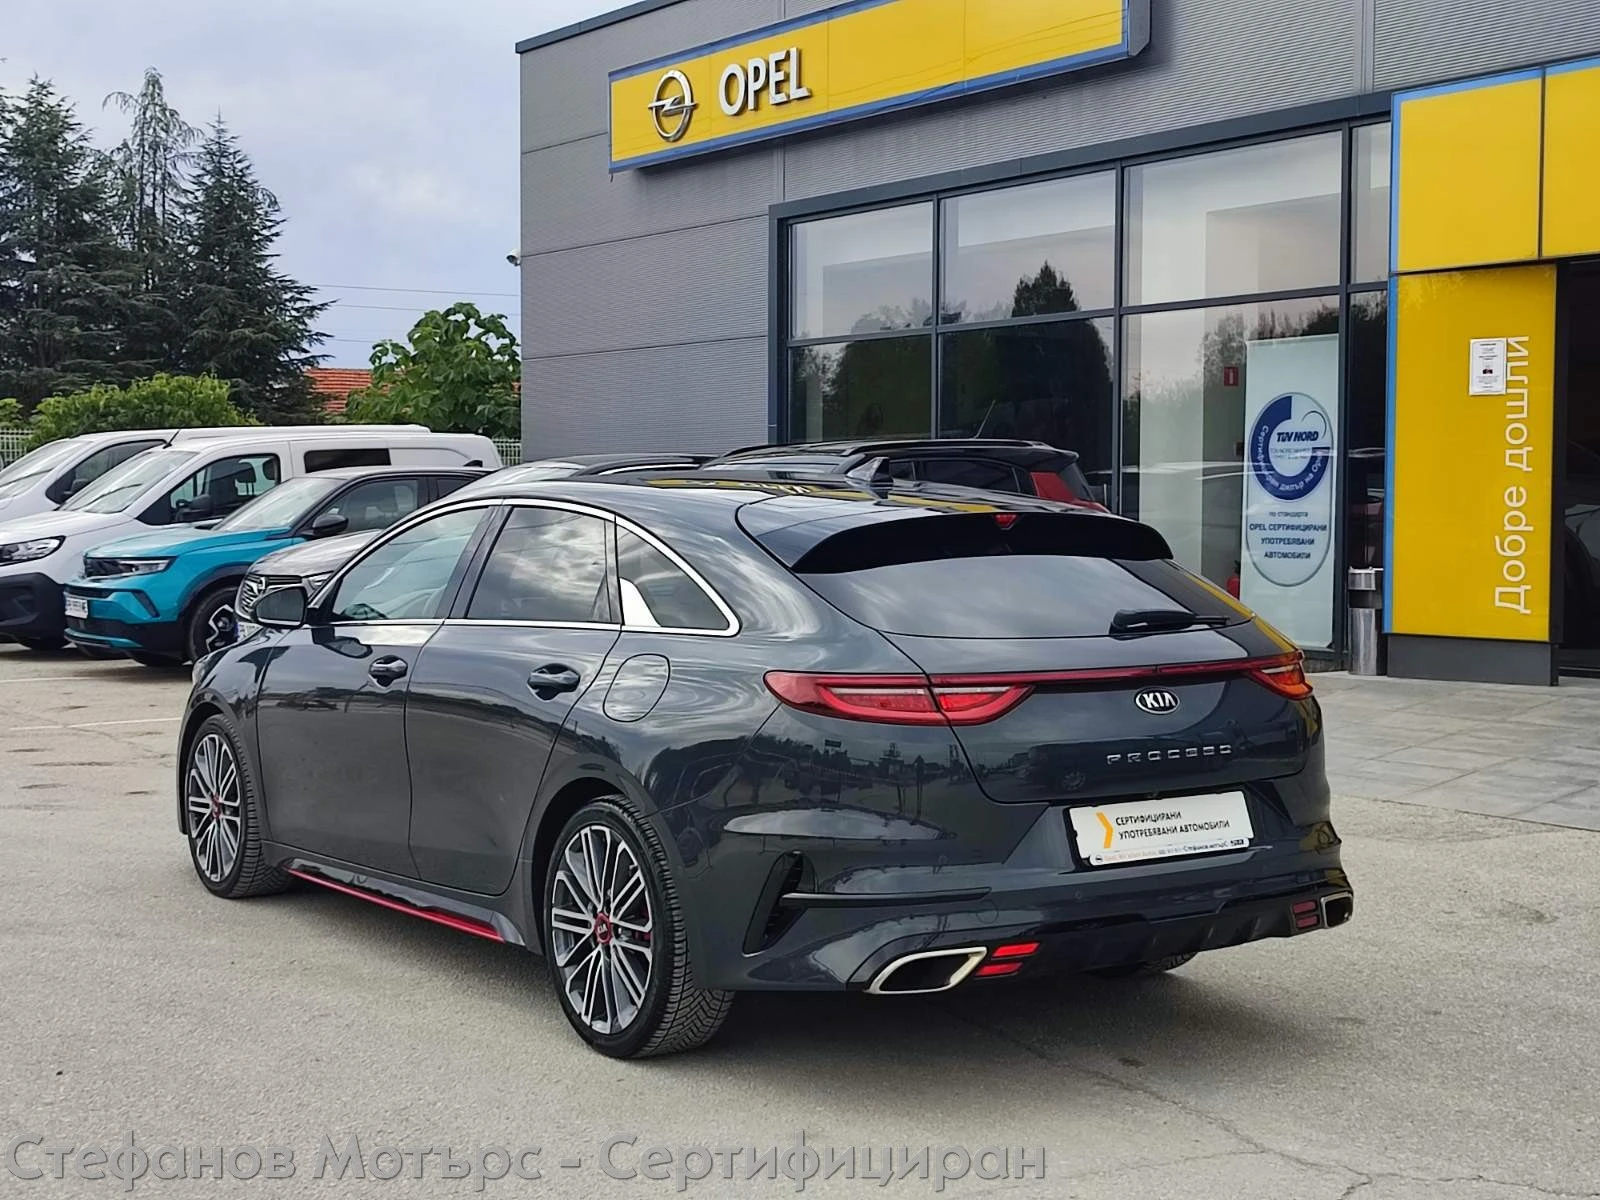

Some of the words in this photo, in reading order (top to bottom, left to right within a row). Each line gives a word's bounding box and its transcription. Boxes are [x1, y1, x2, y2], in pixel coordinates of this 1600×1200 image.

[719, 47, 810, 116] OPEL
[1505, 335, 1534, 471] дошли
[1293, 430, 1319, 442] NORD
[1249, 523, 1267, 532] OPEL
[1268, 523, 1328, 532] СЕРТИФИЦИРАНИ
[1261, 537, 1315, 546] УПОТРЕБЯВАНИ
[1494, 486, 1534, 614] Добре
[1264, 551, 1312, 560] АВТОМОБИЛИ
[1143, 691, 1177, 709] KIA
[1106, 744, 1233, 765] PROCEED
[1115, 811, 1182, 826] СЕРТИФИЦИРАНИ
[1118, 826, 1178, 841] УПОТРЕБЯВАНИ
[1179, 820, 1231, 834] АВТОМОБИЛИ
